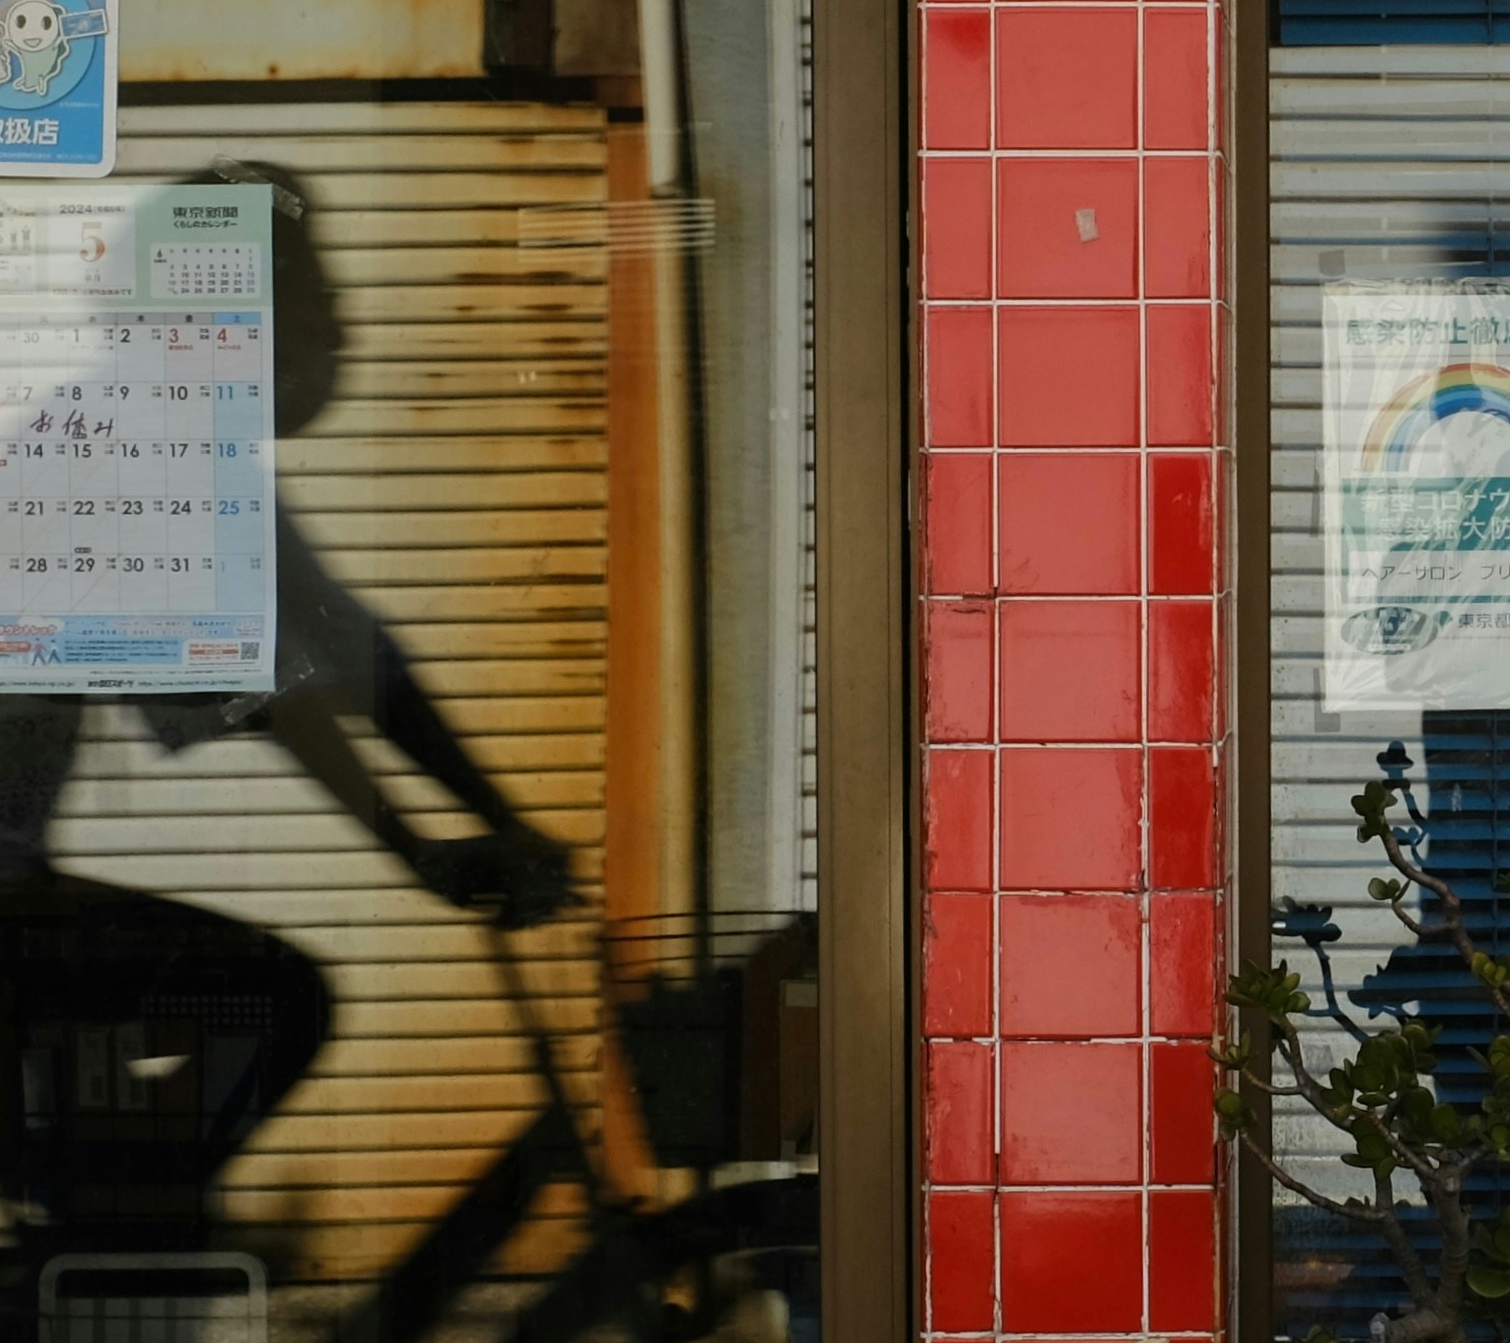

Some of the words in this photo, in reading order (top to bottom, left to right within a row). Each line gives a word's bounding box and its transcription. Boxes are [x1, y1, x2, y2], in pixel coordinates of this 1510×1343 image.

[59, 204, 92, 214] 2024
[173, 206, 238, 218] 東京新聞
[79, 222, 106, 263] 5
[74, 329, 79, 343] 1
[120, 329, 130, 342] 2
[169, 328, 178, 343] 3
[217, 328, 226, 342] 4
[24, 387, 32, 401] 7
[72, 386, 82, 400] 8
[120, 386, 129, 400] 9
[170, 386, 188, 400] 10
[218, 386, 232, 400] 11
[26, 444, 43, 458] 14
[74, 444, 91, 458] 15
[122, 444, 139, 458] 16
[170, 444, 188, 457] 17
[218, 443, 236, 458] 18
[26, 502, 43, 515] 21
[74, 501, 94, 515] 22
[122, 501, 143, 514] 23
[171, 501, 191, 514] 24
[219, 500, 239, 514] 25
[27, 558, 47, 572] 28
[75, 558, 95, 572] 29
[124, 558, 144, 572] 30
[171, 558, 188, 572] 31
[1361, 564, 1463, 582] ヘアーサロン
